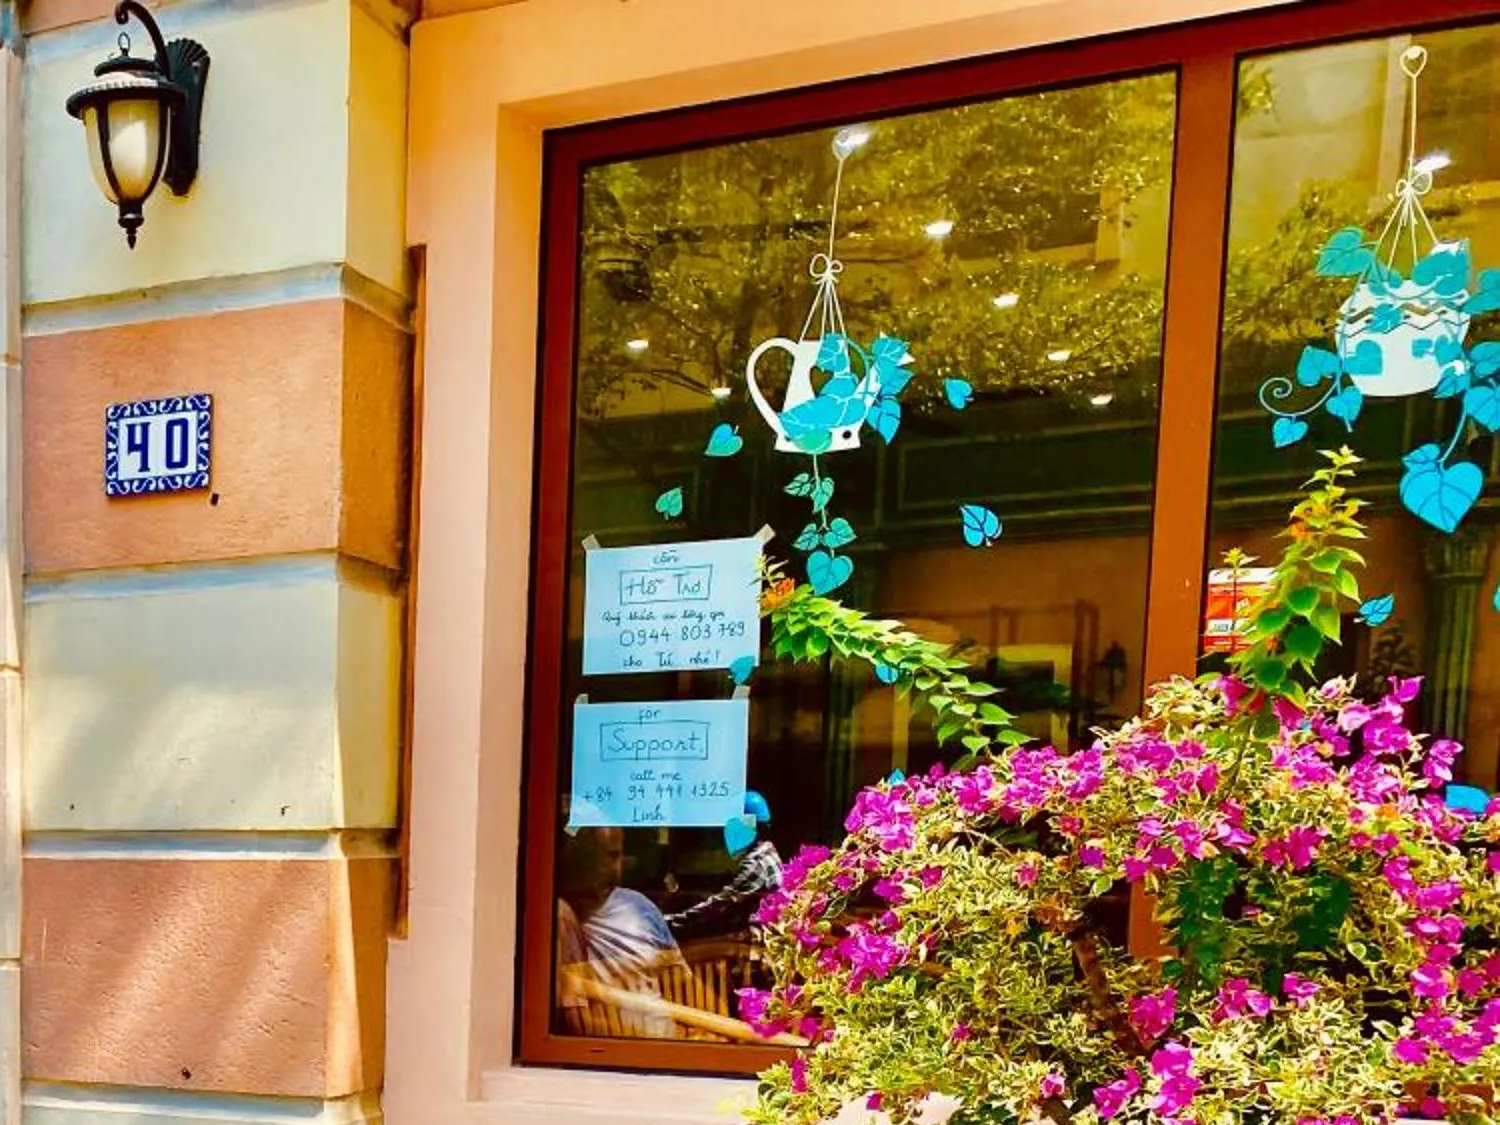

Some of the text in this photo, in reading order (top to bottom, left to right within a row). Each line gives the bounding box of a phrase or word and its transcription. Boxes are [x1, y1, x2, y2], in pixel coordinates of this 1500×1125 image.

[125, 418, 189, 473] 40
[619, 626, 672, 647] 0944
[681, 623, 712, 642] 803
[608, 728, 702, 761] Support
